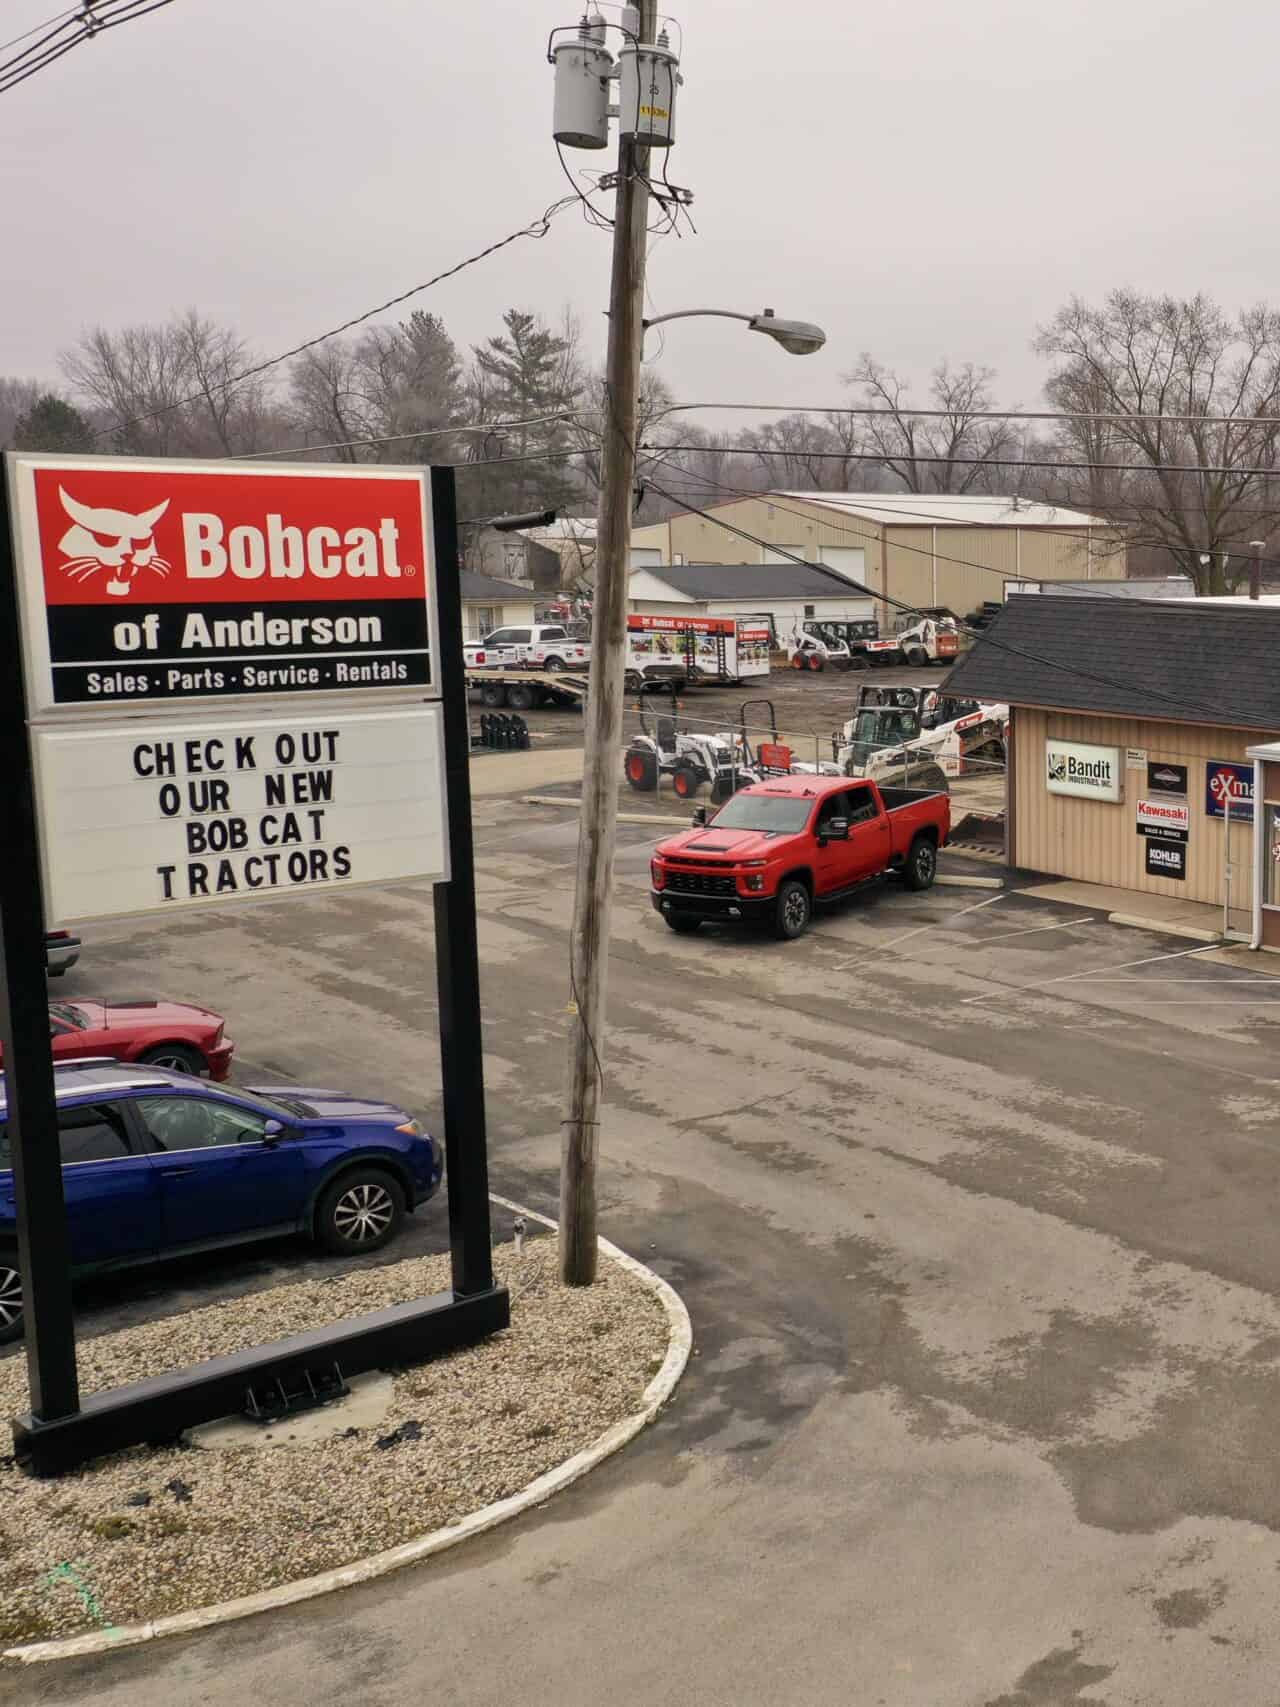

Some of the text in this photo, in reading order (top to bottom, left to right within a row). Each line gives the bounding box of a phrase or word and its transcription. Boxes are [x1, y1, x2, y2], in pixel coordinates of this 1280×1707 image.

[181, 512, 402, 580] Bobcat
[113, 612, 382, 651] of Anderson
[87, 660, 408, 694] Sales Parts Service Rentals
[133, 730, 340, 777] CHECK OUT
[1068, 756, 1111, 779] Bandit
[159, 770, 333, 818] OUR NEW
[1210, 773, 1255, 801] eXma
[1138, 802, 1187, 820] Kawasaki
[157, 846, 351, 900] TRACTORS
[1149, 848, 1181, 863] KOHLER
